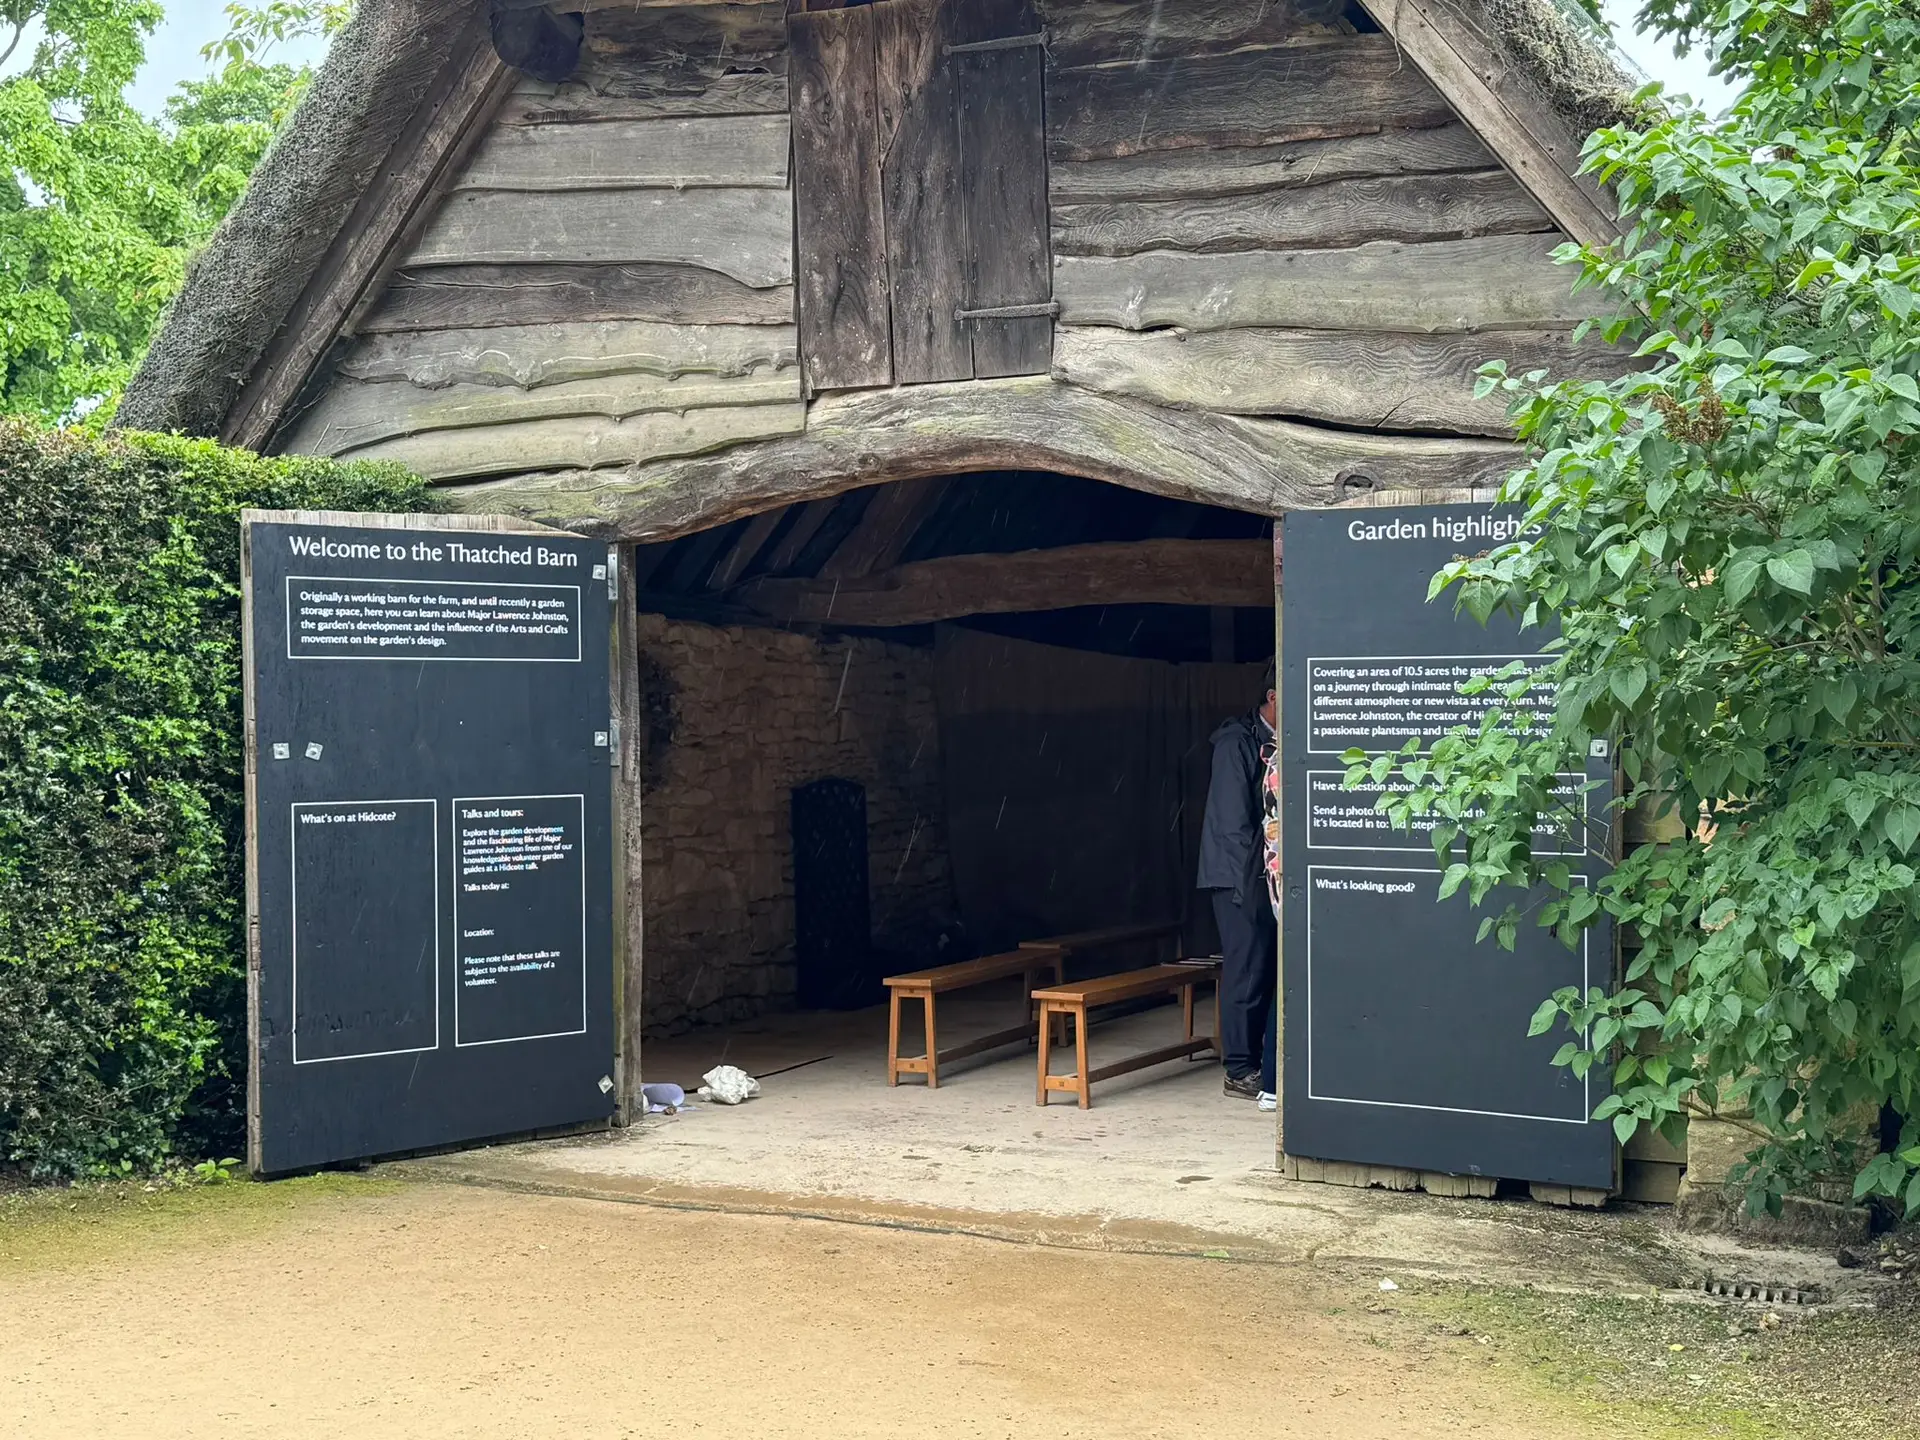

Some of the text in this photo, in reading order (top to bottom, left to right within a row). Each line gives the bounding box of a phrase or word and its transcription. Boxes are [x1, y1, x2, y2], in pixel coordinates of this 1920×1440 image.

[1348, 519, 1426, 540] Garden
[289, 536, 577, 566] Welcome to the Thatched Barn
[300, 591, 342, 603] Originally
[351, 593, 386, 604] working
[387, 594, 407, 603] barn
[409, 594, 421, 603] for
[423, 595, 436, 604] the
[438, 595, 460, 606] farm,
[462, 597, 477, 605] and
[479, 597, 497, 606] until
[499, 598, 530, 608] recently
[538, 599, 564, 609] garden
[301, 607, 334, 617] storage
[335, 609, 363, 617] space,
[364, 607, 383, 616] here
[385, 610, 400, 618] you
[419, 608, 440, 617] learn
[442, 609, 465, 618] about
[468, 610, 491, 620] Major
[493, 611, 530, 620] Lawrence
[532, 611, 569, 622] Johnston,
[301, 620, 568, 634] the garden's development and the influence of the Arts and Crafts
[363, 635, 378, 644] the
[379, 635, 415, 646] garden's
[417, 636, 447, 647] design.
[1314, 667, 1355, 678] Covering
[1392, 666, 1403, 676] of
[1404, 666, 1423, 676] 10.5
[1425, 668, 1450, 676] acres
[1452, 666, 1468, 675] the
[1470, 664, 1503, 678] garde
[1333, 682, 1370, 693] journey
[1372, 682, 1410, 693] through
[1412, 681, 1451, 691] intimate
[1314, 696, 1353, 706] different
[1354, 696, 1410, 707] atmosphere
[1446, 696, 1469, 705] vista
[1470, 697, 1481, 705] at
[1483, 698, 1509, 709] every
[1314, 711, 1357, 720] Lawrence
[1358, 711, 1404, 722] Johnston,
[1406, 711, 1422, 720] the
[1424, 712, 1459, 720] creator
[1461, 710, 1472, 720] of
[1321, 726, 1370, 737] passionate
[1372, 726, 1421, 738] plantsman
[1423, 725, 1441, 735] and
[1313, 781, 1336, 790] Have
[462, 809, 482, 818] Talks
[484, 808, 499, 817] and
[1313, 805, 1337, 815] Send
[1346, 806, 1374, 817] photo
[301, 814, 332, 823] What's
[347, 814, 356, 822] at
[358, 812, 396, 821] Hidcote?
[1314, 817, 1328, 827] it's
[1329, 818, 1363, 828] located
[1365, 818, 1374, 828] in
[1376, 820, 1389, 828] to:
[463, 829, 487, 837] Explore
[501, 828, 522, 837] garden
[523, 827, 563, 835] development
[489, 836, 523, 845] fascinating
[543, 834, 561, 844] Major
[463, 854, 511, 865] knowledgeable
[542, 852, 564, 861] garden
[464, 865, 485, 875] guides
[499, 863, 524, 871] Hidcote
[525, 862, 538, 870] talk.
[482, 882, 500, 890] today
[1316, 879, 1415, 893] What's looking good?
[464, 929, 494, 937] Location:
[465, 968, 490, 976] subject
[510, 962, 542, 971] availability
[465, 978, 497, 986] volunteer.
